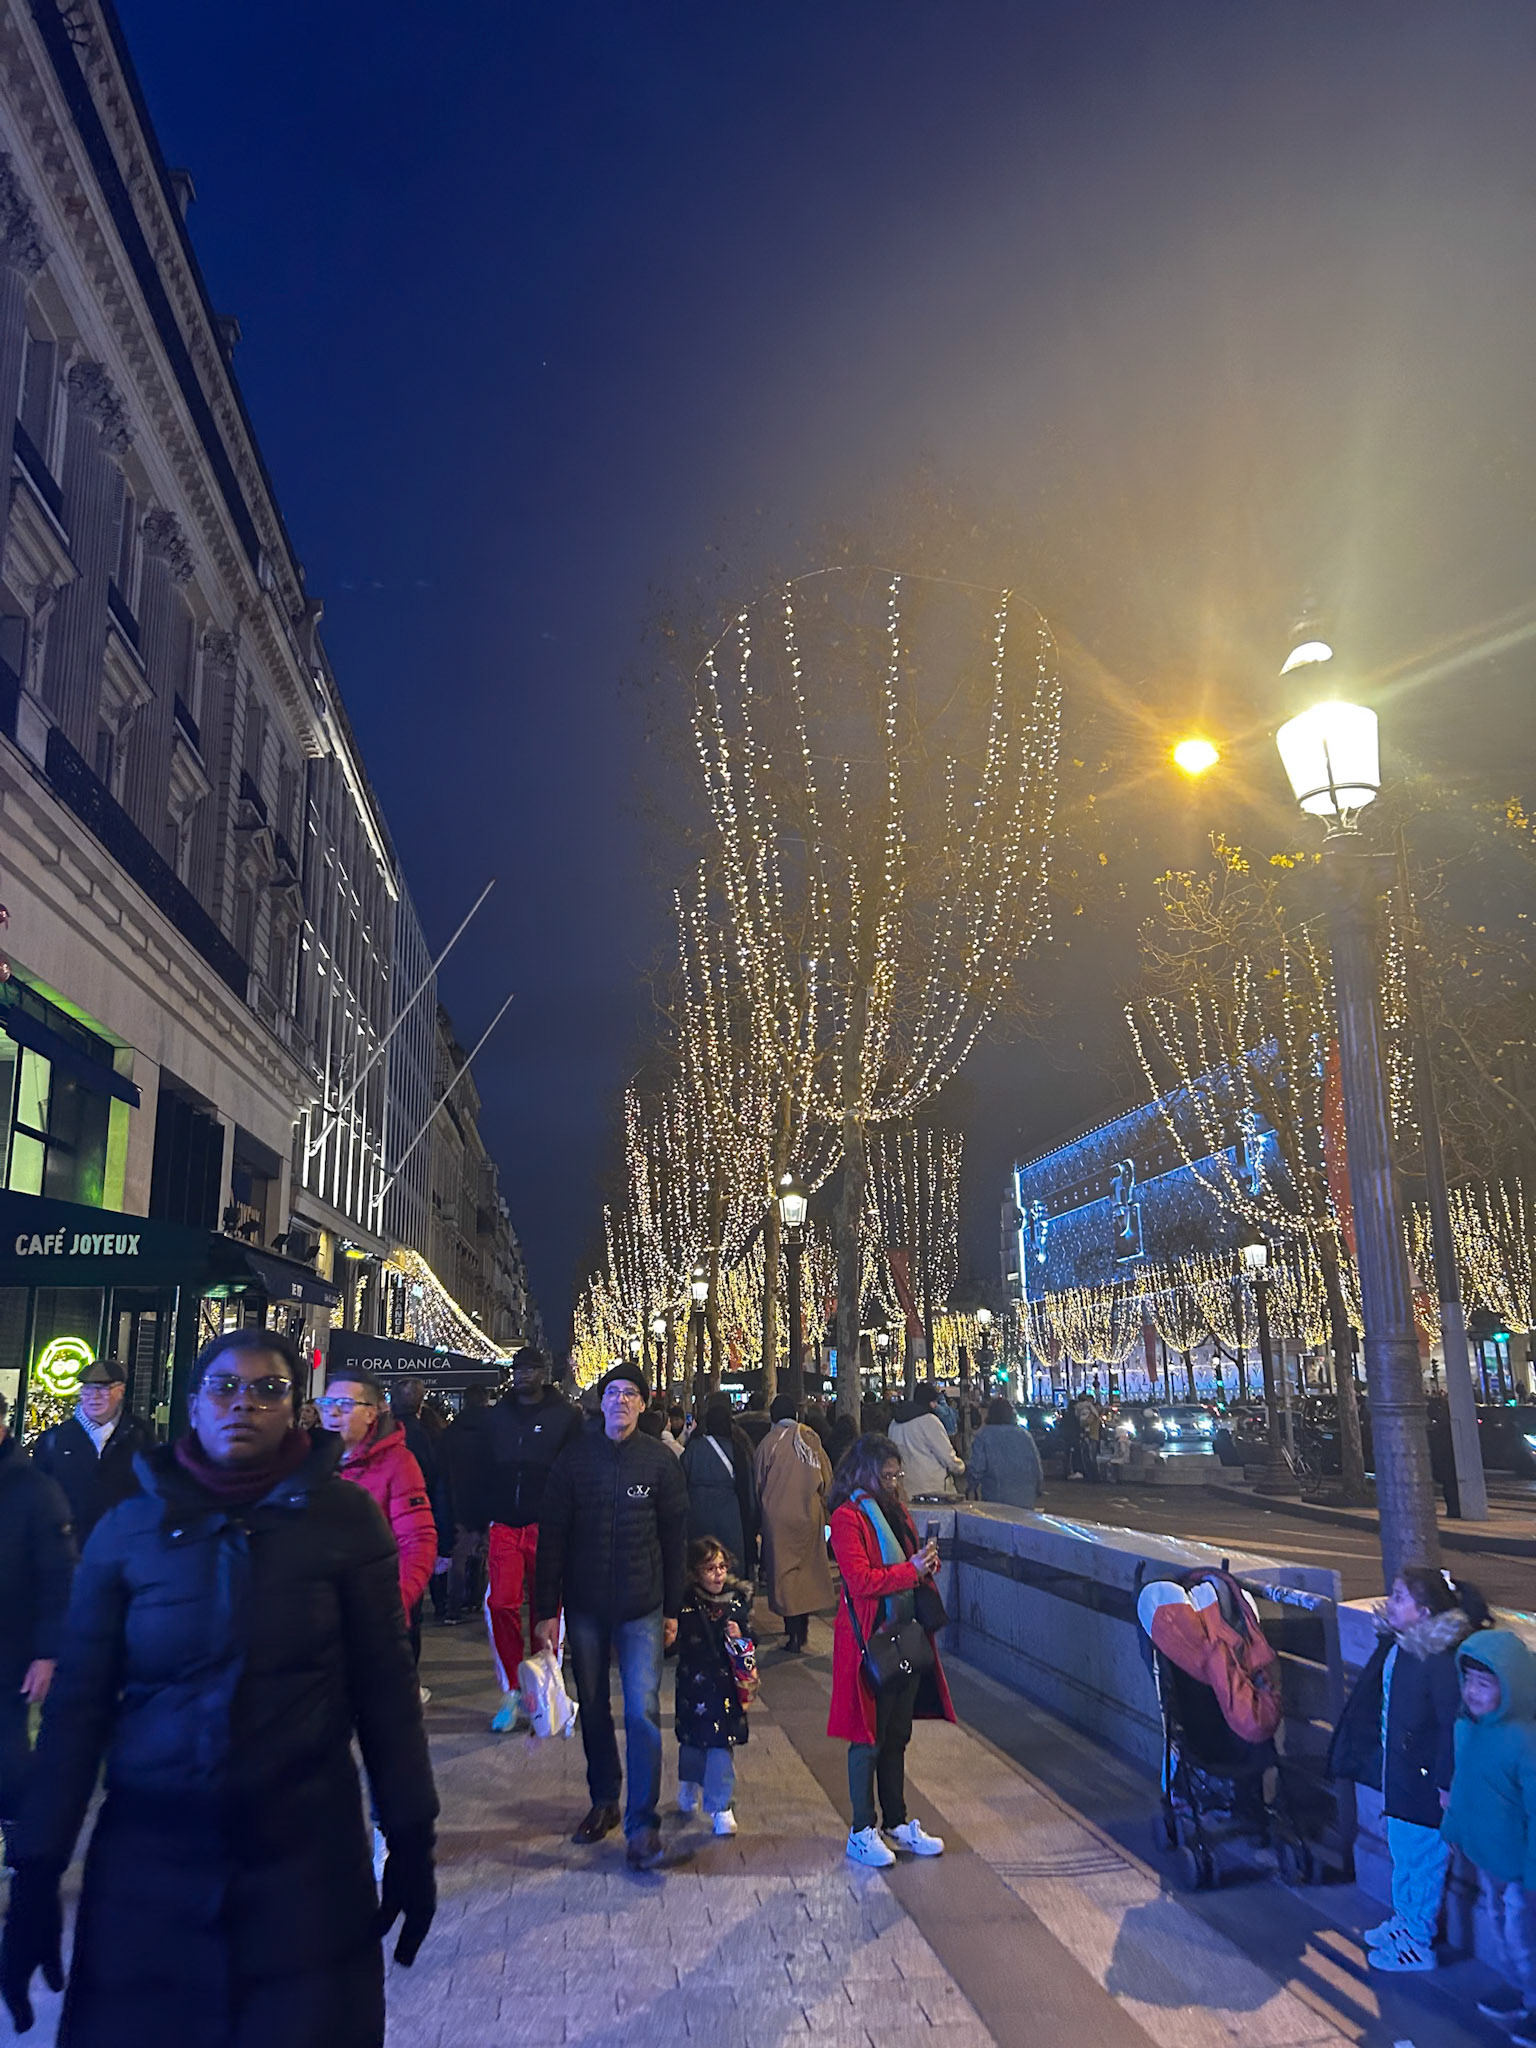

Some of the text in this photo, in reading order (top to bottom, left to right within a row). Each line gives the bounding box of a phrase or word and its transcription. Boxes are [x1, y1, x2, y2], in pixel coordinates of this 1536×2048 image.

[15, 1226, 140, 1256] CAFÉ JOYEUX
[394, 1288, 403, 1334] CHANGE
[397, 1357, 451, 1370] DANICA
